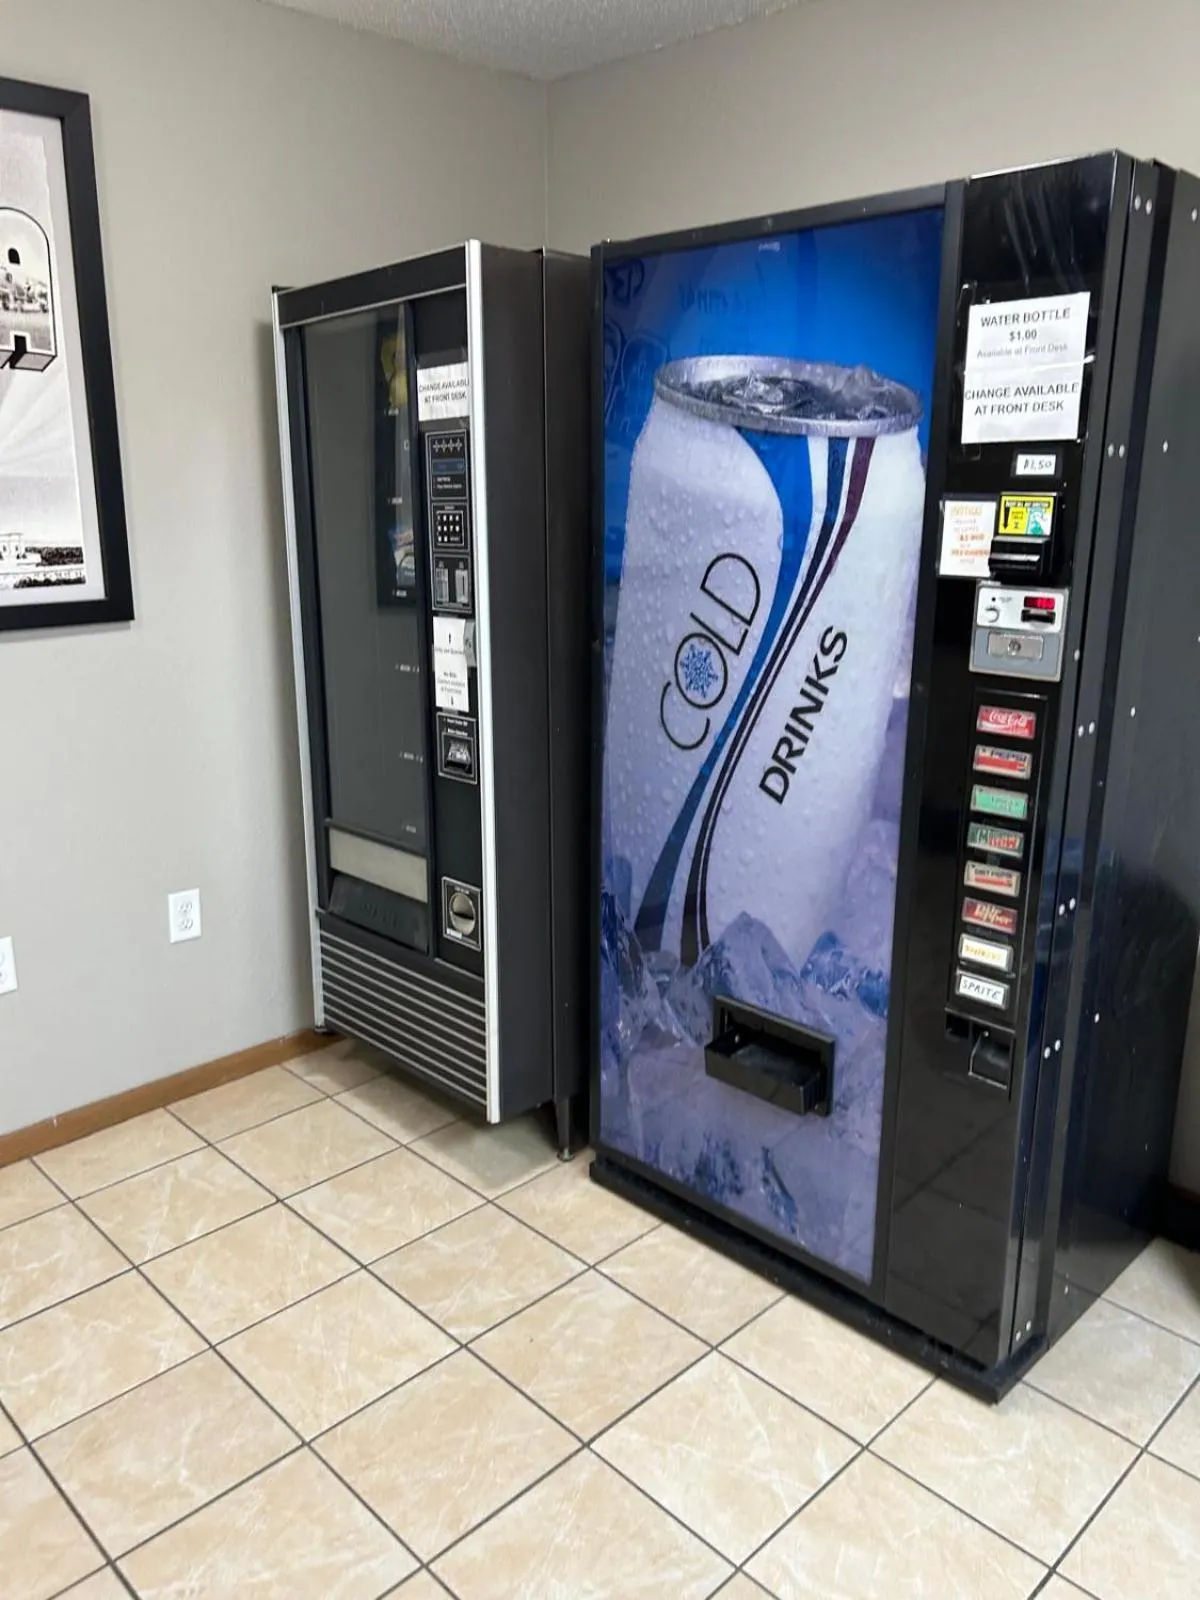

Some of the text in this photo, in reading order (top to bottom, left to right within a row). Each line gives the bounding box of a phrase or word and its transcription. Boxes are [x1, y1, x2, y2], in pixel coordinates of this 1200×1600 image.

[980, 307, 1071, 327] WATER BOTTLE
[1009, 329, 1038, 341] $1.00
[1024, 344, 1046, 354] Front
[1048, 342, 1068, 352] Desk
[964, 382, 1080, 400] CHANGE AVAILABLE
[974, 399, 1064, 416] AT FRONT DESK
[660, 552, 761, 751] COLD
[758, 624, 848, 805] DRINKS
[961, 979, 1001, 999] SPRITE
